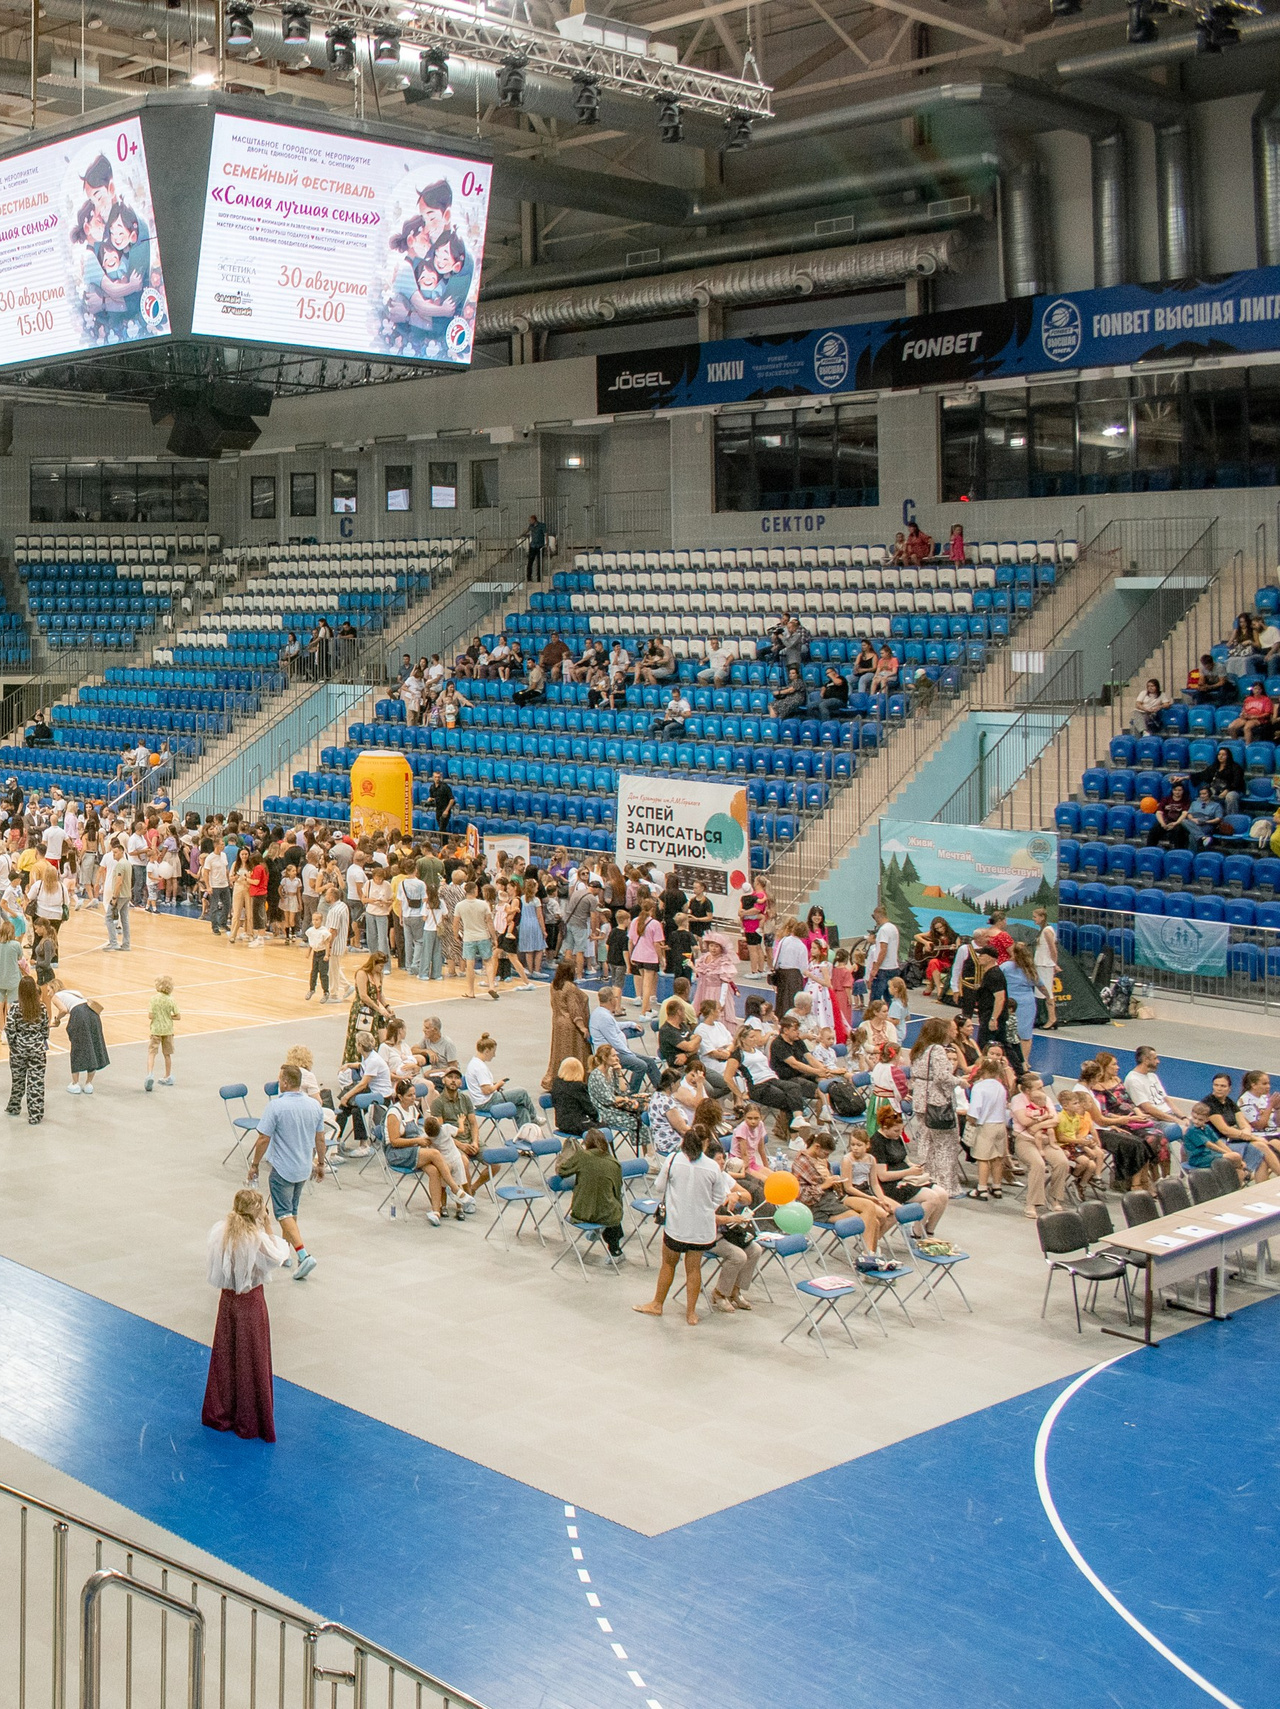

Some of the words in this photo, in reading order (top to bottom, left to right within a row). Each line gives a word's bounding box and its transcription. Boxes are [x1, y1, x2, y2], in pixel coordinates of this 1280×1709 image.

[117, 133, 138, 162] 0+
[232, 134, 279, 149] МАСШТАБНОЕ
[282, 143, 322, 157] ГОРОДСКОЕ
[325, 151, 371, 166] МЕРОПРИЯТИЕ
[270, 150, 307, 162] ЕДИНОБОРСТВ
[223, 162, 298, 187] СЕМЕЙНЫЙ
[301, 176, 376, 199] ФЕСТИВАЛЬ
[461, 171, 484, 197] 0+
[211, 185, 272, 209] «Самая
[276, 199, 328, 218] лучшая
[332, 208, 381, 226] семья»
[21, 214, 58, 236] семья»
[217, 263, 256, 275] ЭСТЕТИКА
[221, 273, 251, 284] УСПЕХА
[277, 265, 302, 288] 30
[305, 271, 368, 299] августа
[18, 286, 65, 310] августа
[296, 297, 345, 323] 15:00
[1093, 309, 1150, 338] FONBET
[1154, 300, 1234, 331] ВЫСШАЯ
[17, 310, 53, 336] 15:00
[901, 331, 983, 362] FONBET
[1047, 335, 1076, 348] ВЫСШАЯ
[608, 371, 671, 391] JÖGEL
[707, 360, 745, 383] XXXIV
[761, 515, 826, 533] СЕКТОР
[627, 804, 673, 821] УСПЕЙ
[626, 821, 722, 844] ЗАПИСАТЬСЯ
[907, 836, 935, 849] Живи,
[626, 838, 635, 850] В
[639, 839, 706, 859] СТУДИЮ!
[937, 849, 975, 862] Мечтай,
[975, 862, 1042, 878] Путешествуй!
